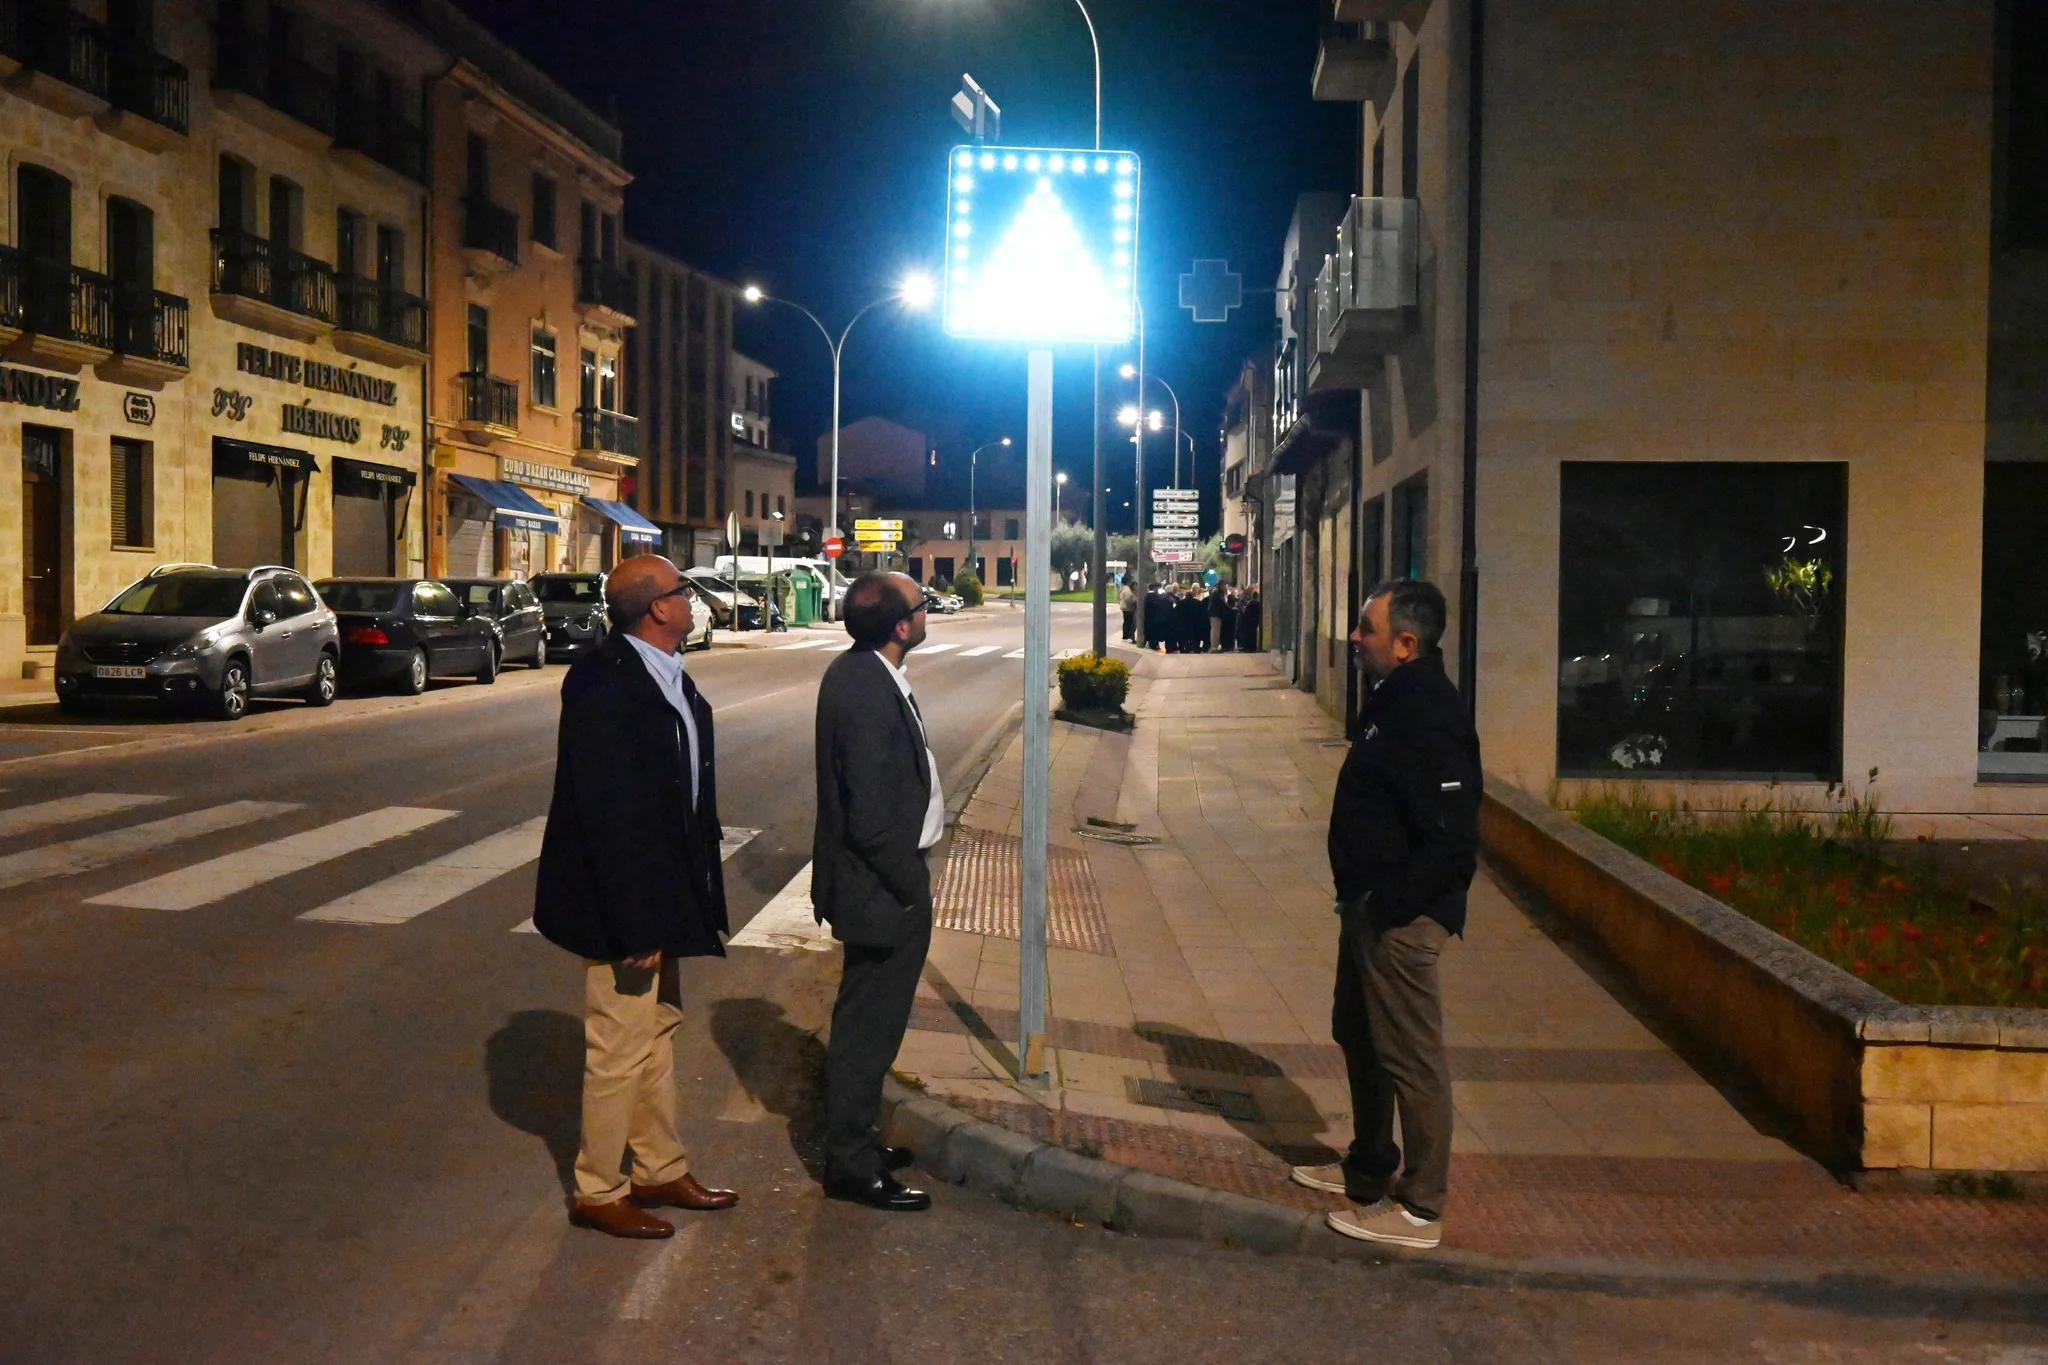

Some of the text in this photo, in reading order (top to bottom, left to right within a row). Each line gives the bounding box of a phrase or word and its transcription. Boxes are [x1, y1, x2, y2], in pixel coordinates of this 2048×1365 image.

[237, 342, 398, 406] FELIPE HERNÁNDEZ
[281, 398, 361, 444] IBÉRICOS
[248, 452, 300, 468] FELIPE HERNÁNDEZ
[504, 459, 524, 475] EURO
[526, 463, 548, 479] BAZAR
[361, 470, 375, 480] FELIPE
[98, 667, 143, 677] 0826 LCR
